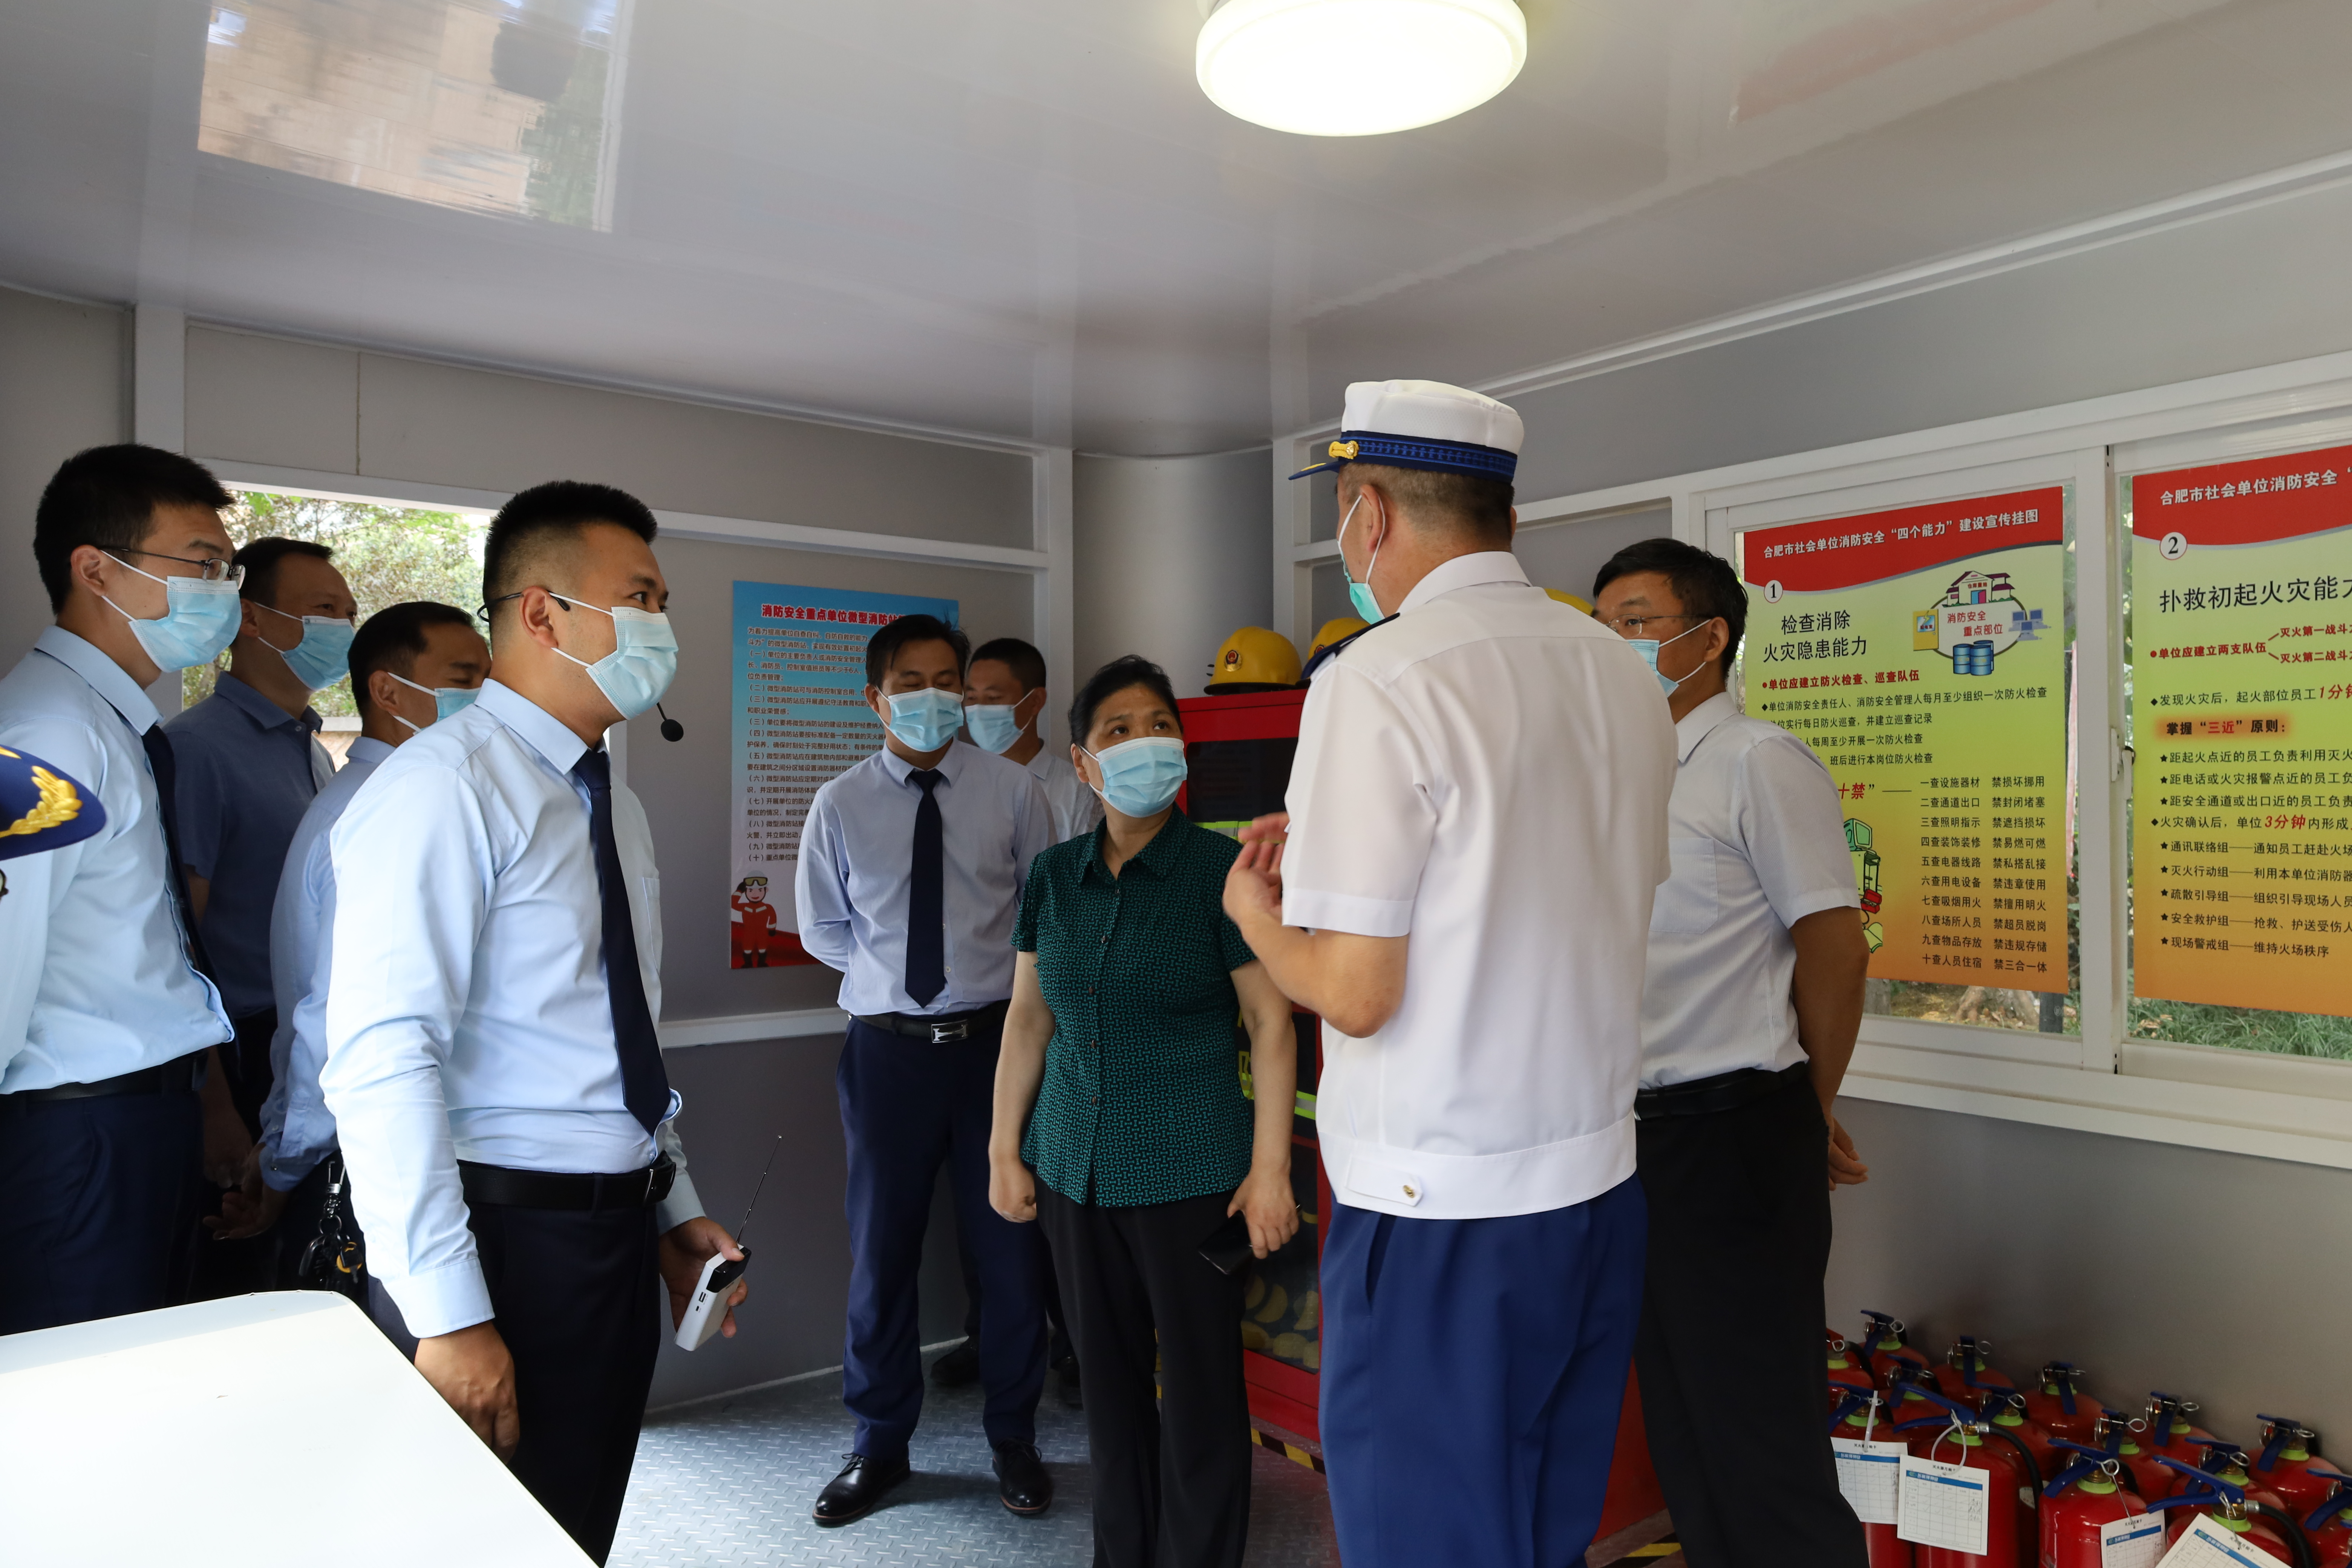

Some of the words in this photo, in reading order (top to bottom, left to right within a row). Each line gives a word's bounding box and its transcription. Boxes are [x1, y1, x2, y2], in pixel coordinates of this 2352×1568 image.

[2168, 536, 2179, 554] 2
[1770, 583, 1778, 599] 1
[1781, 609, 1851, 635] 检查消除
[1947, 611, 1986, 623] 消防安全
[1963, 623, 2003, 637] 重点部位
[1763, 635, 1867, 663] 火灾隐患能力
[2159, 642, 2267, 659] 单位应建立两支队伍
[748, 662, 867, 674] 长、消防员、控制室值班员等不少于6人，
[1769, 669, 1920, 691] 单位应建立防火检查、巡查队伍
[750, 695, 870, 707] （三）微型消防站应开展遵纪守法教育和职
[1769, 687, 2047, 712] 单位消防安全责任人、消防安全管理人每月至少组织一次防火检查
[750, 729, 885, 740] （四）微型消防站要按标准配备一定数量的灭火器
[1798, 733, 1923, 747] 人每周至少开展一次防火检查
[1920, 777, 1980, 789] 一查设施器材
[1992, 776, 2045, 787] 禁损坏挪用
[1920, 797, 1980, 808] 二查通道出口
[1992, 797, 2045, 808] 禁封闭堵塞
[1921, 817, 1980, 828] 三查照明指示
[1992, 817, 2046, 829] 禁遮挡损坏
[2161, 814, 2352, 830] 火灾确认后，单位3分钟内形成
[1921, 837, 1981, 848] 四查装饰装修
[1992, 837, 2046, 849] 禁易燃可燃
[1921, 857, 1981, 868] 五查电器线路
[1993, 858, 2046, 870] 禁私搭乱接
[1922, 876, 1981, 888] 六查用电设备
[1993, 877, 2046, 890] 禁违章使用
[1922, 895, 1981, 908] 七查吸烟用火
[1994, 898, 2047, 911] 禁擅用明火
[1922, 915, 1981, 928] 八查场所人员
[1994, 918, 2047, 932] 禁超员脱岗
[1922, 934, 1982, 948] 九查物品存放
[1994, 938, 2047, 952] 禁违规存储
[1922, 954, 1982, 969] 十查人员住宿
[1994, 959, 2047, 973] 禁三合一体
